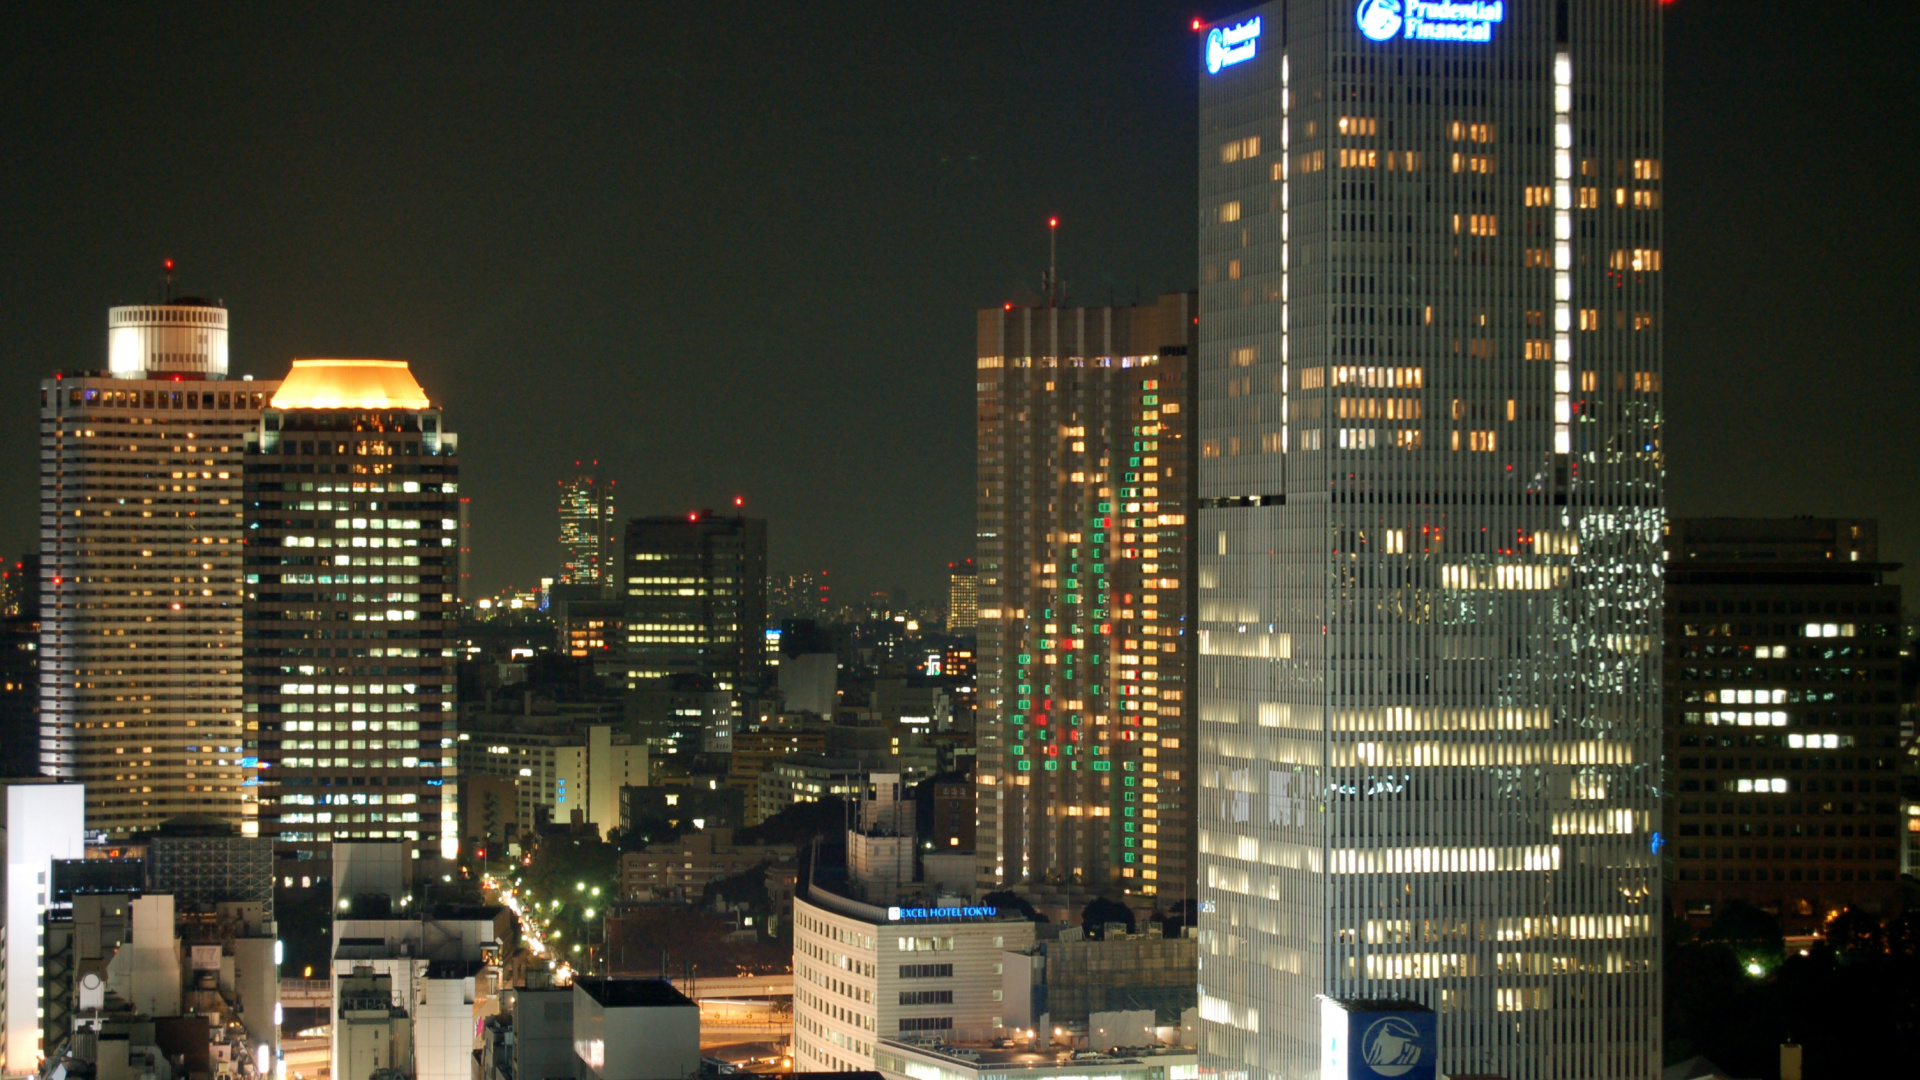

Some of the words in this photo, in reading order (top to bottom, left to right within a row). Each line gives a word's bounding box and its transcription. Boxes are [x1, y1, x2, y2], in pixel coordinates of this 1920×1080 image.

[1405, 0, 1502, 22] Prudential
[1404, 18, 1491, 42] Financial
[900, 908, 928, 918] EXCEL
[930, 907, 961, 917] HOTEL
[962, 906, 997, 917] TOKYU
